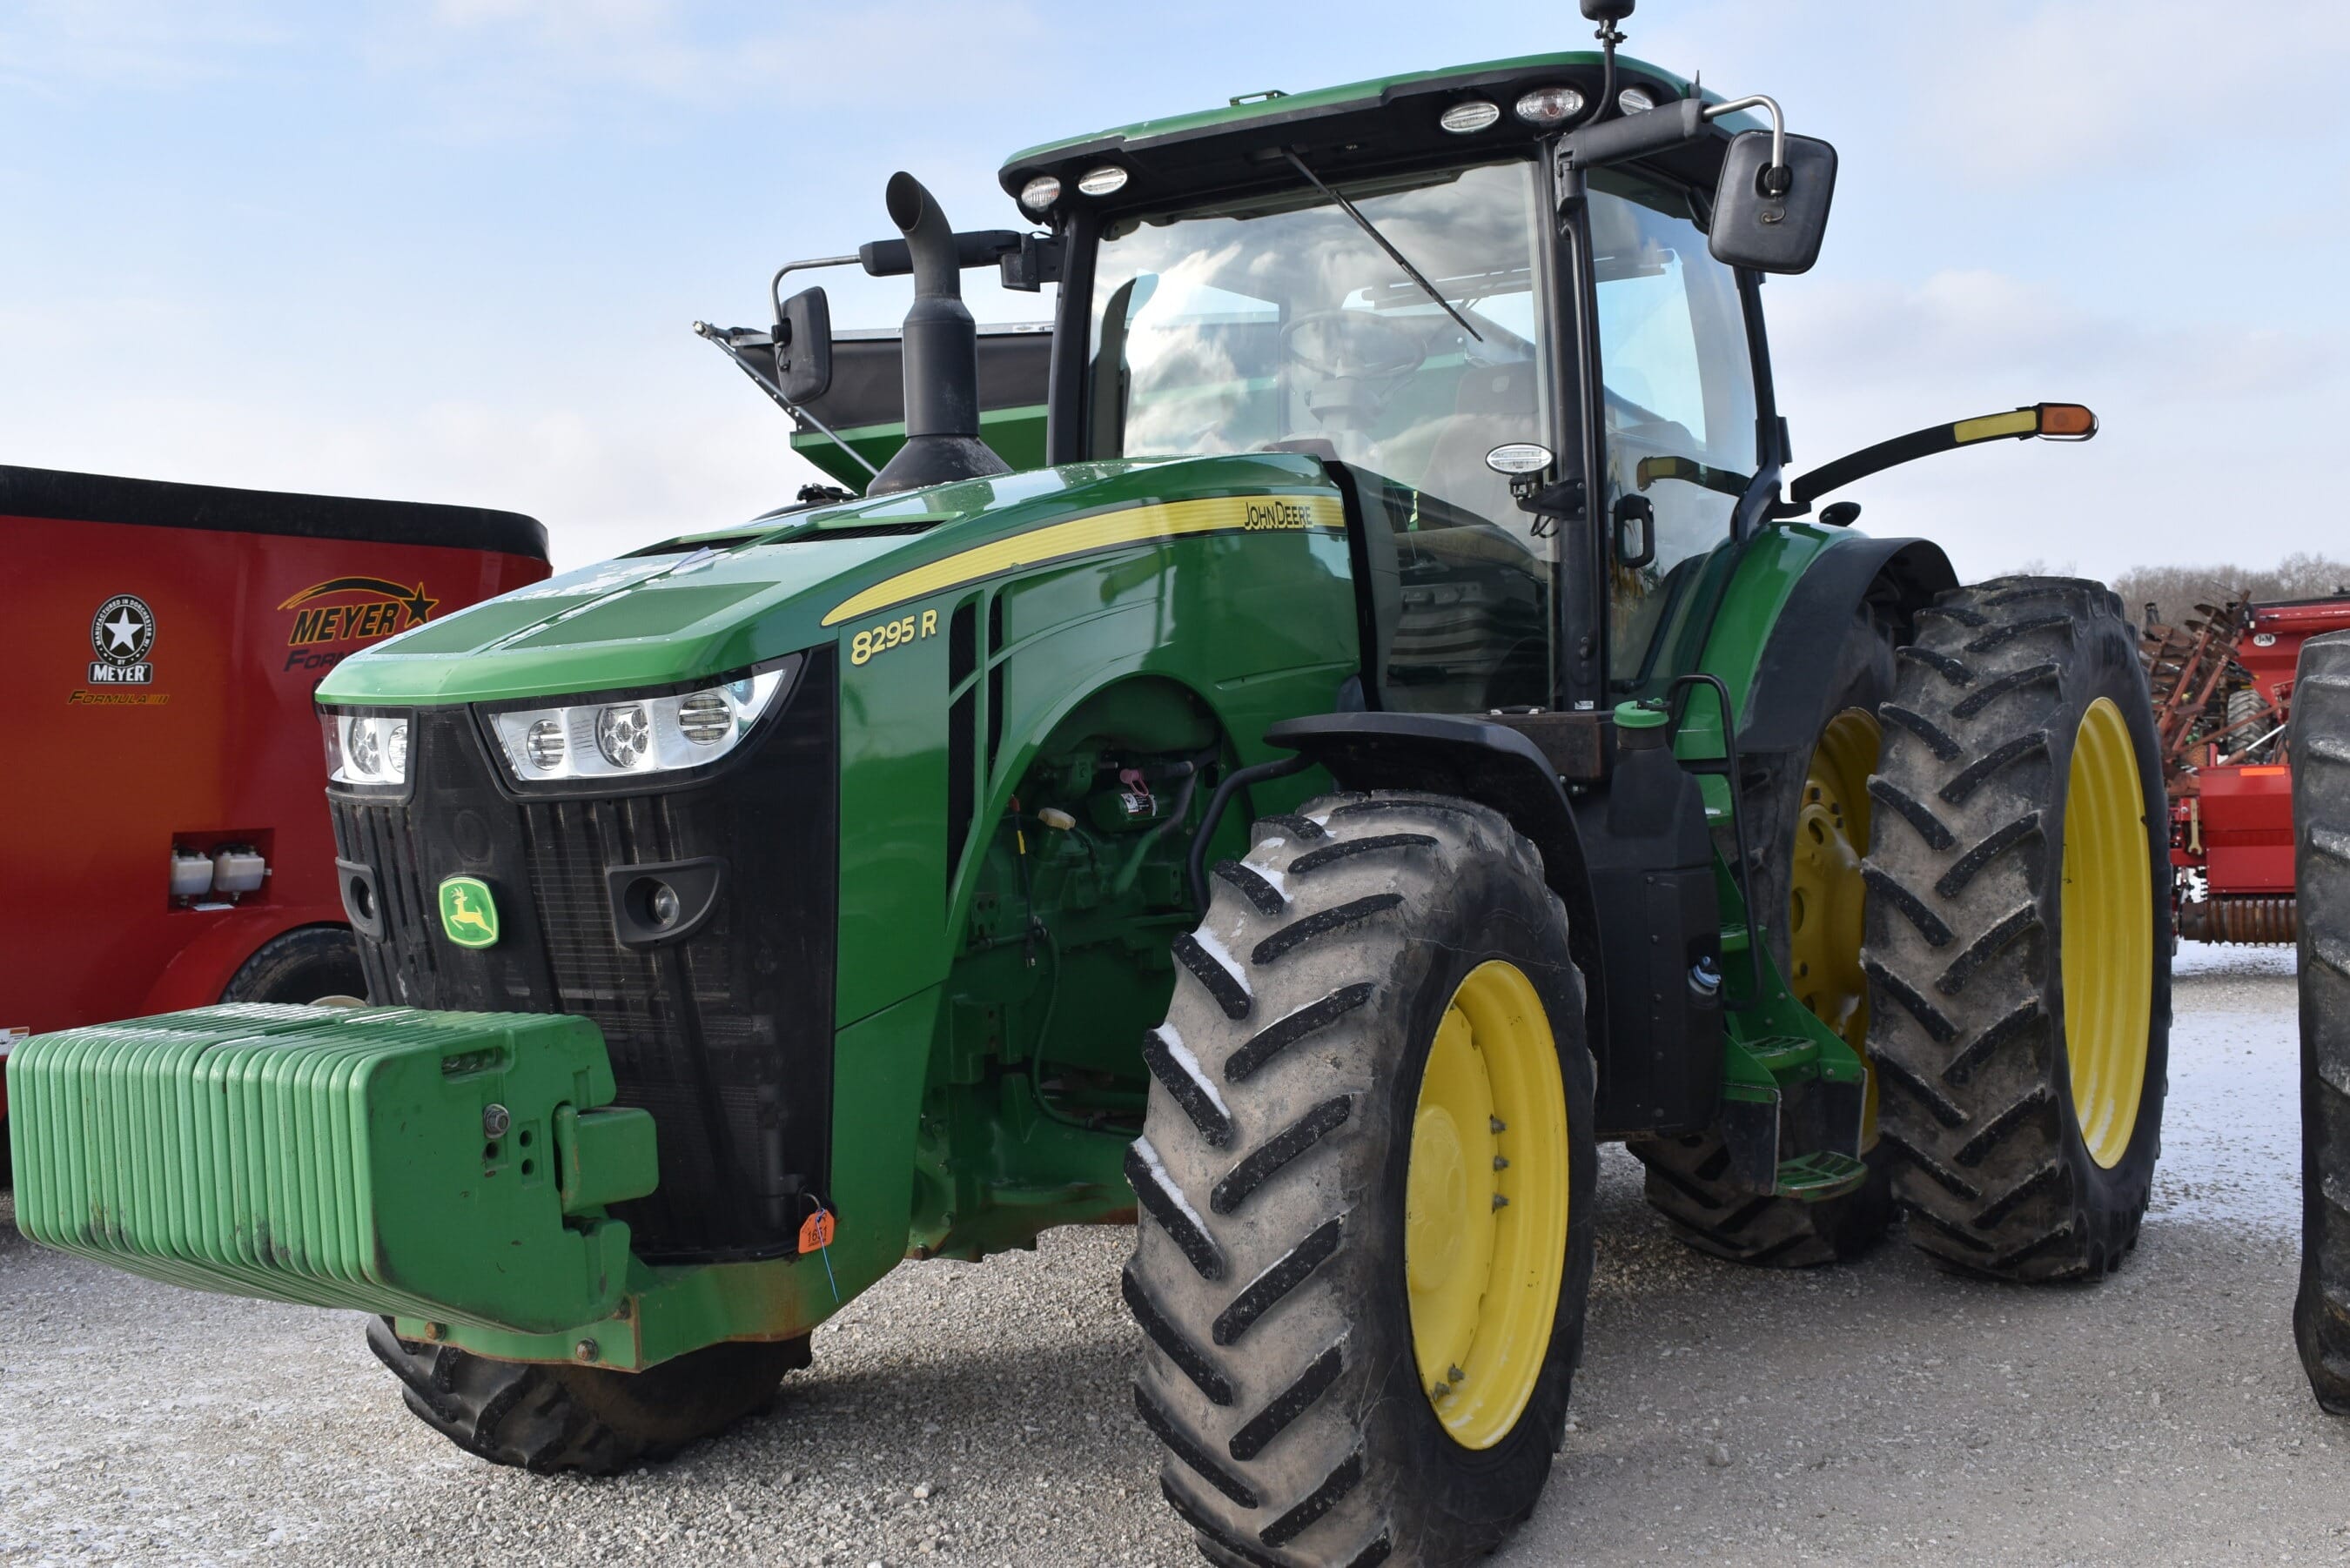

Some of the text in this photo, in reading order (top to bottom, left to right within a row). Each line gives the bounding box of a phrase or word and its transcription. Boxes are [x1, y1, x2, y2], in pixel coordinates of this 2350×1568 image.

[130, 600, 152, 637] DORCHESTER
[287, 601, 401, 646] MEYER
[850, 608, 938, 667] 8295 R
[93, 664, 145, 681] MEYER
